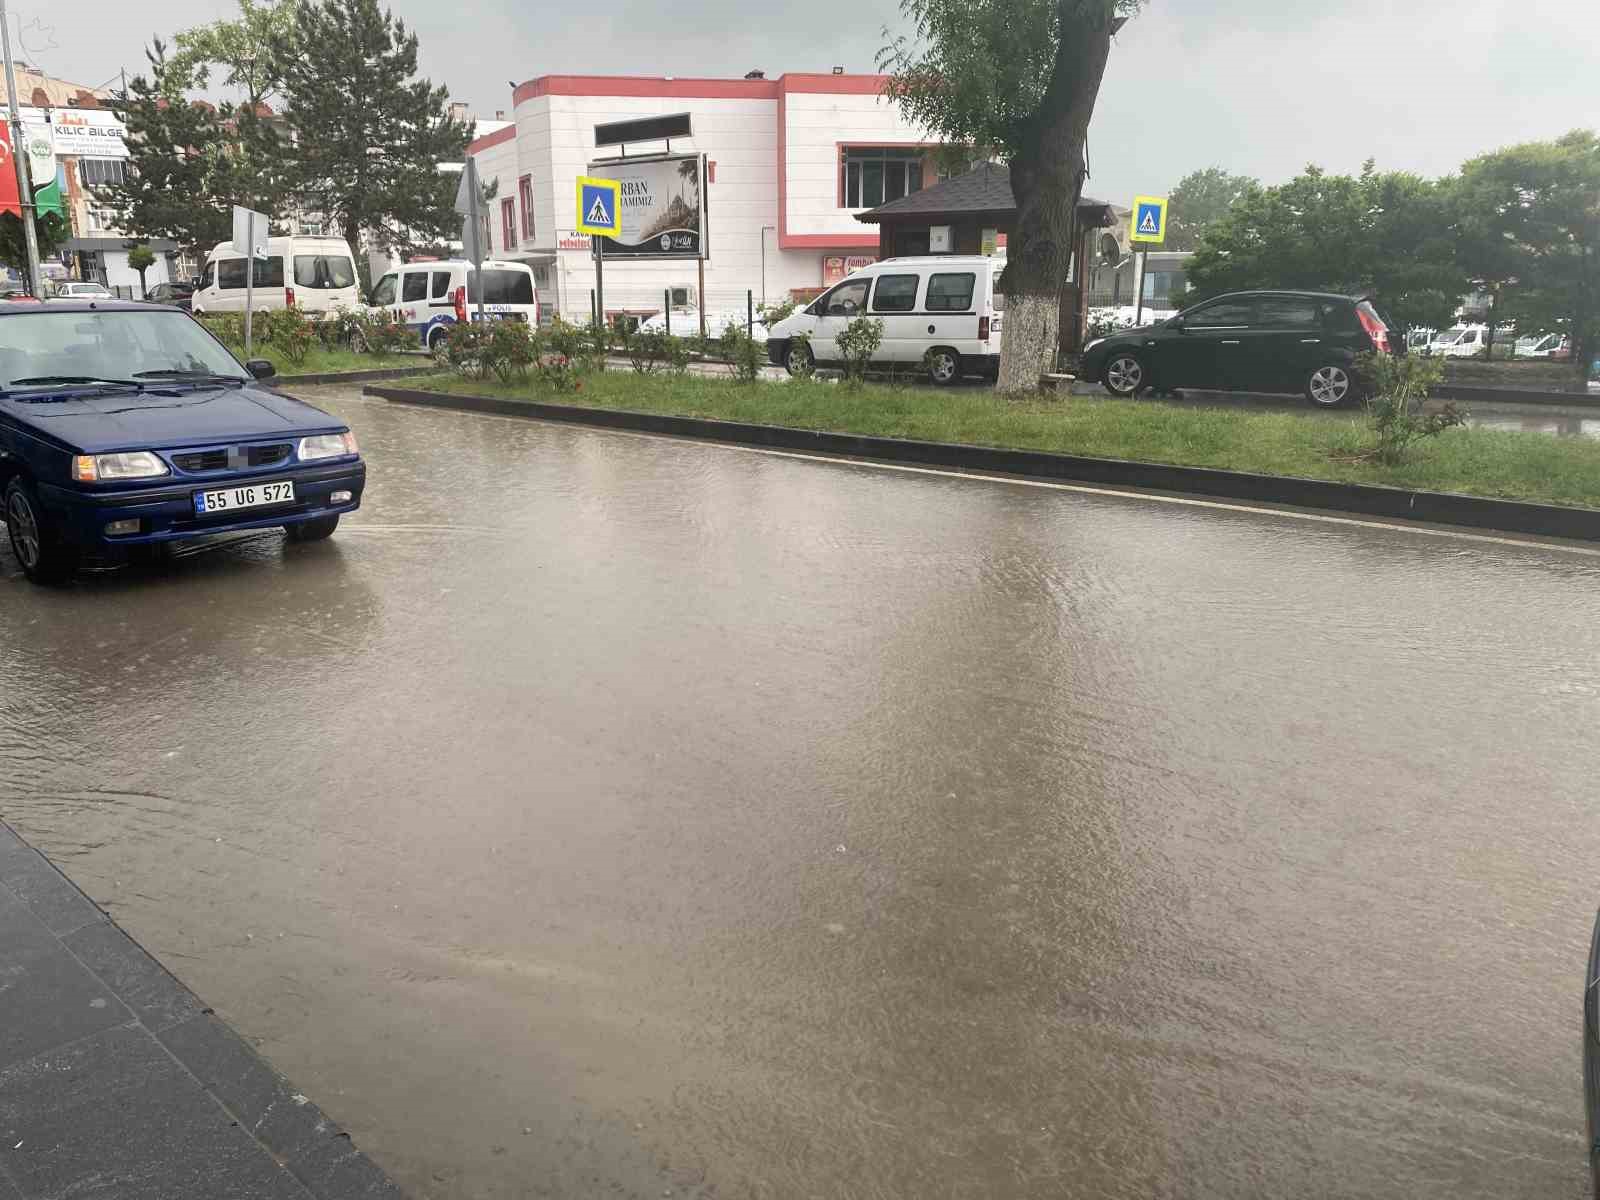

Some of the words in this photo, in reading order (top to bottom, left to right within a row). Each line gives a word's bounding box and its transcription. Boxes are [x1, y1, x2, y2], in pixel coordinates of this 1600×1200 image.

[206, 492, 227, 509] 55
[235, 488, 255, 505] UG
[263, 484, 291, 501] 572
